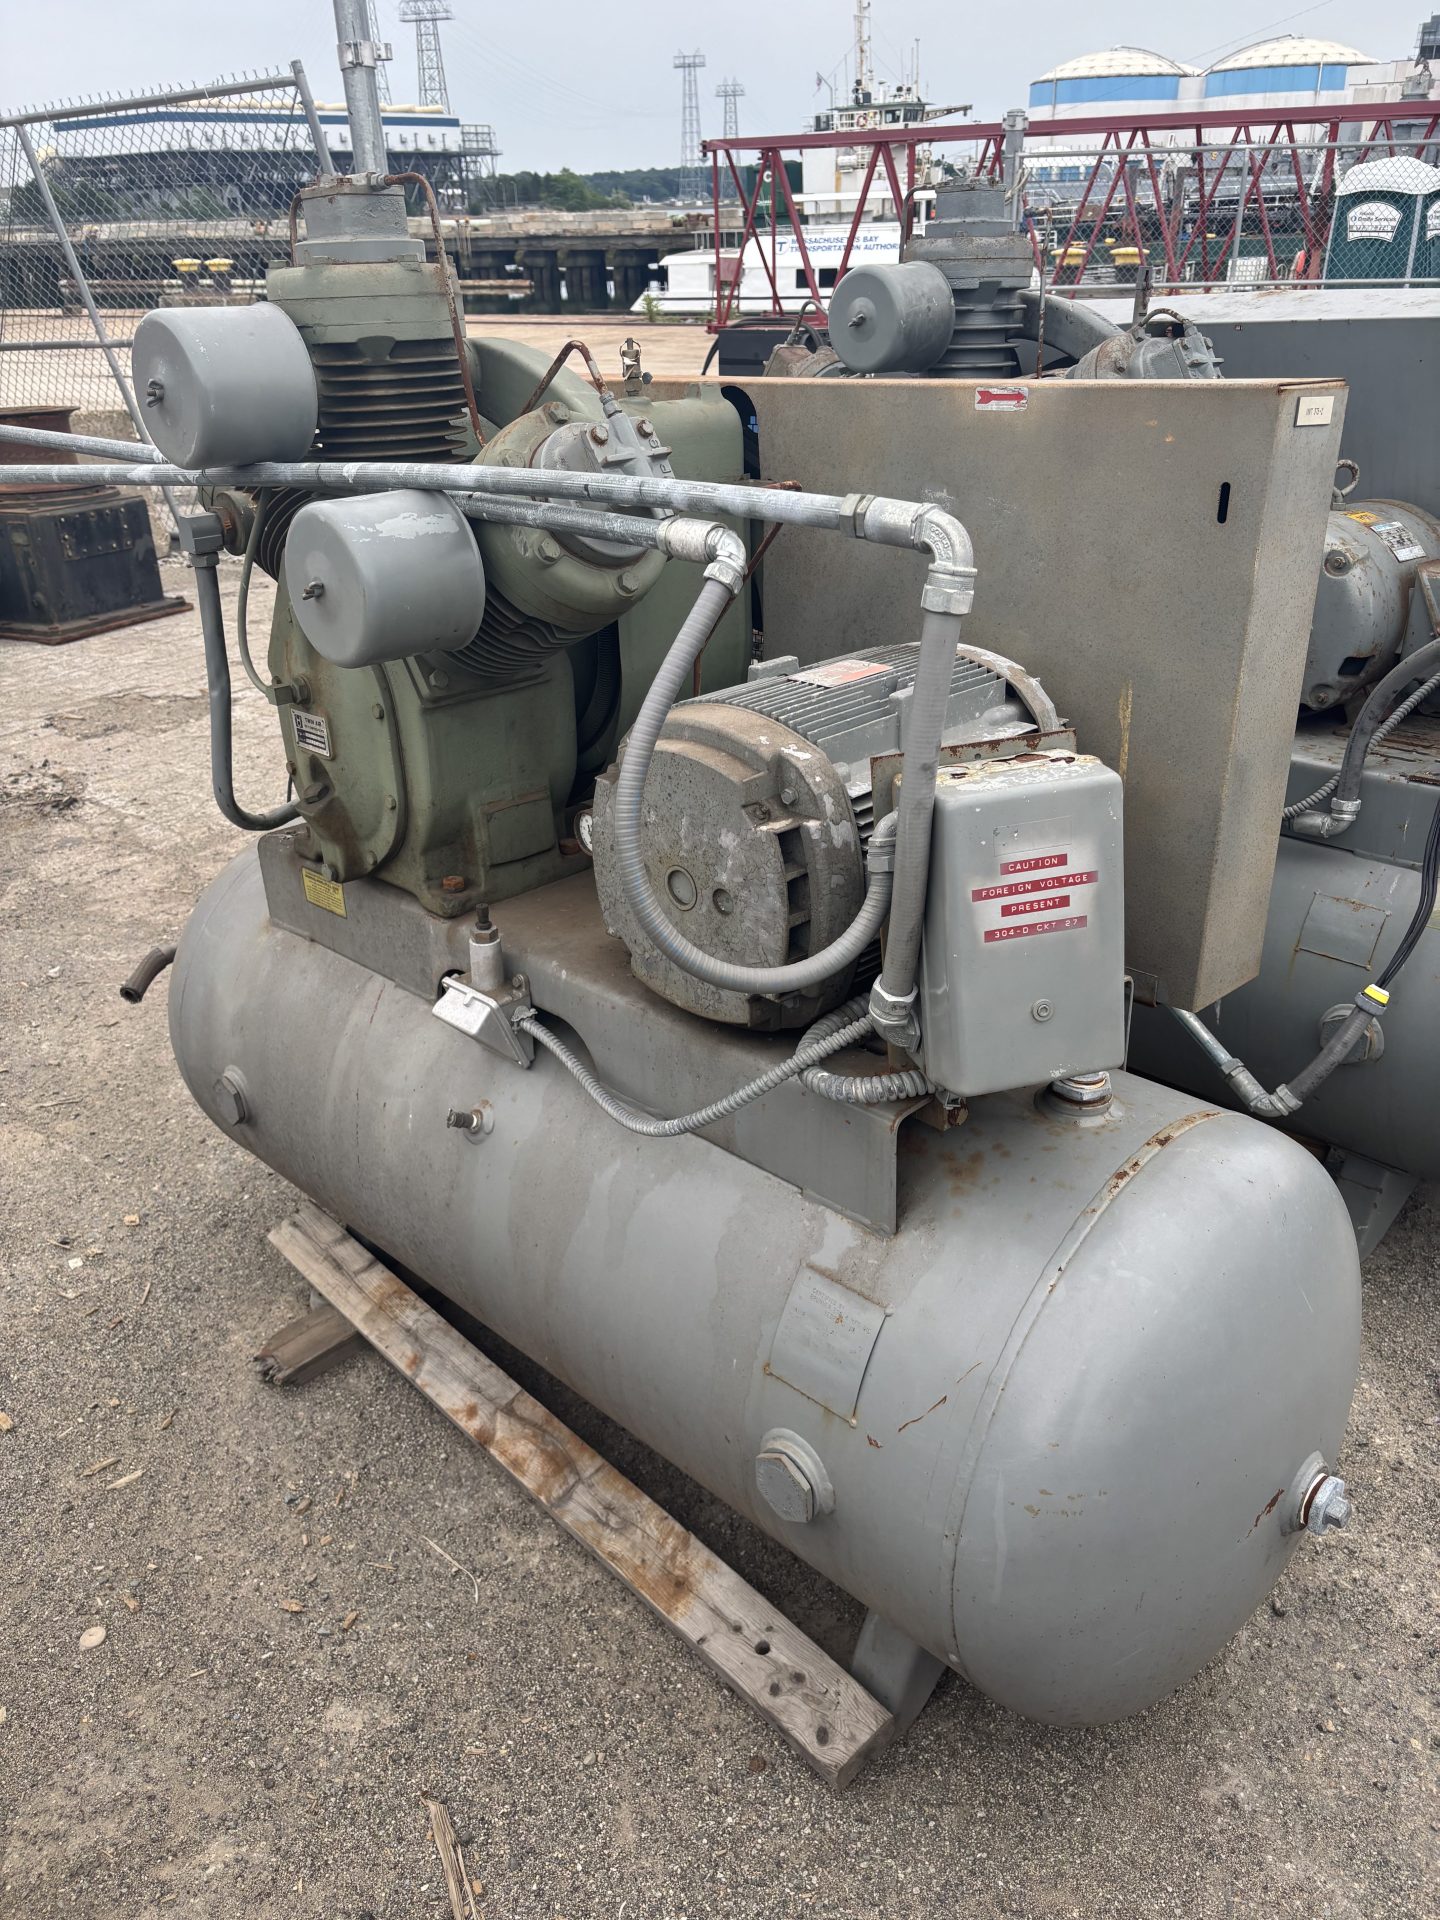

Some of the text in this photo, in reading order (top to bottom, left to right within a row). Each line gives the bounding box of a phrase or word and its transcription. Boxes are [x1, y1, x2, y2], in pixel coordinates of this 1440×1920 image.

[863, 235, 879, 243] BAY
[776, 241, 787, 252] T
[1008, 858, 1058, 872] CAUTION
[982, 874, 1088, 898] FOREIGN VOLTAGE
[1011, 898, 1060, 913] PRESENT
[994, 919, 1078, 939] 304-D CKT 27
